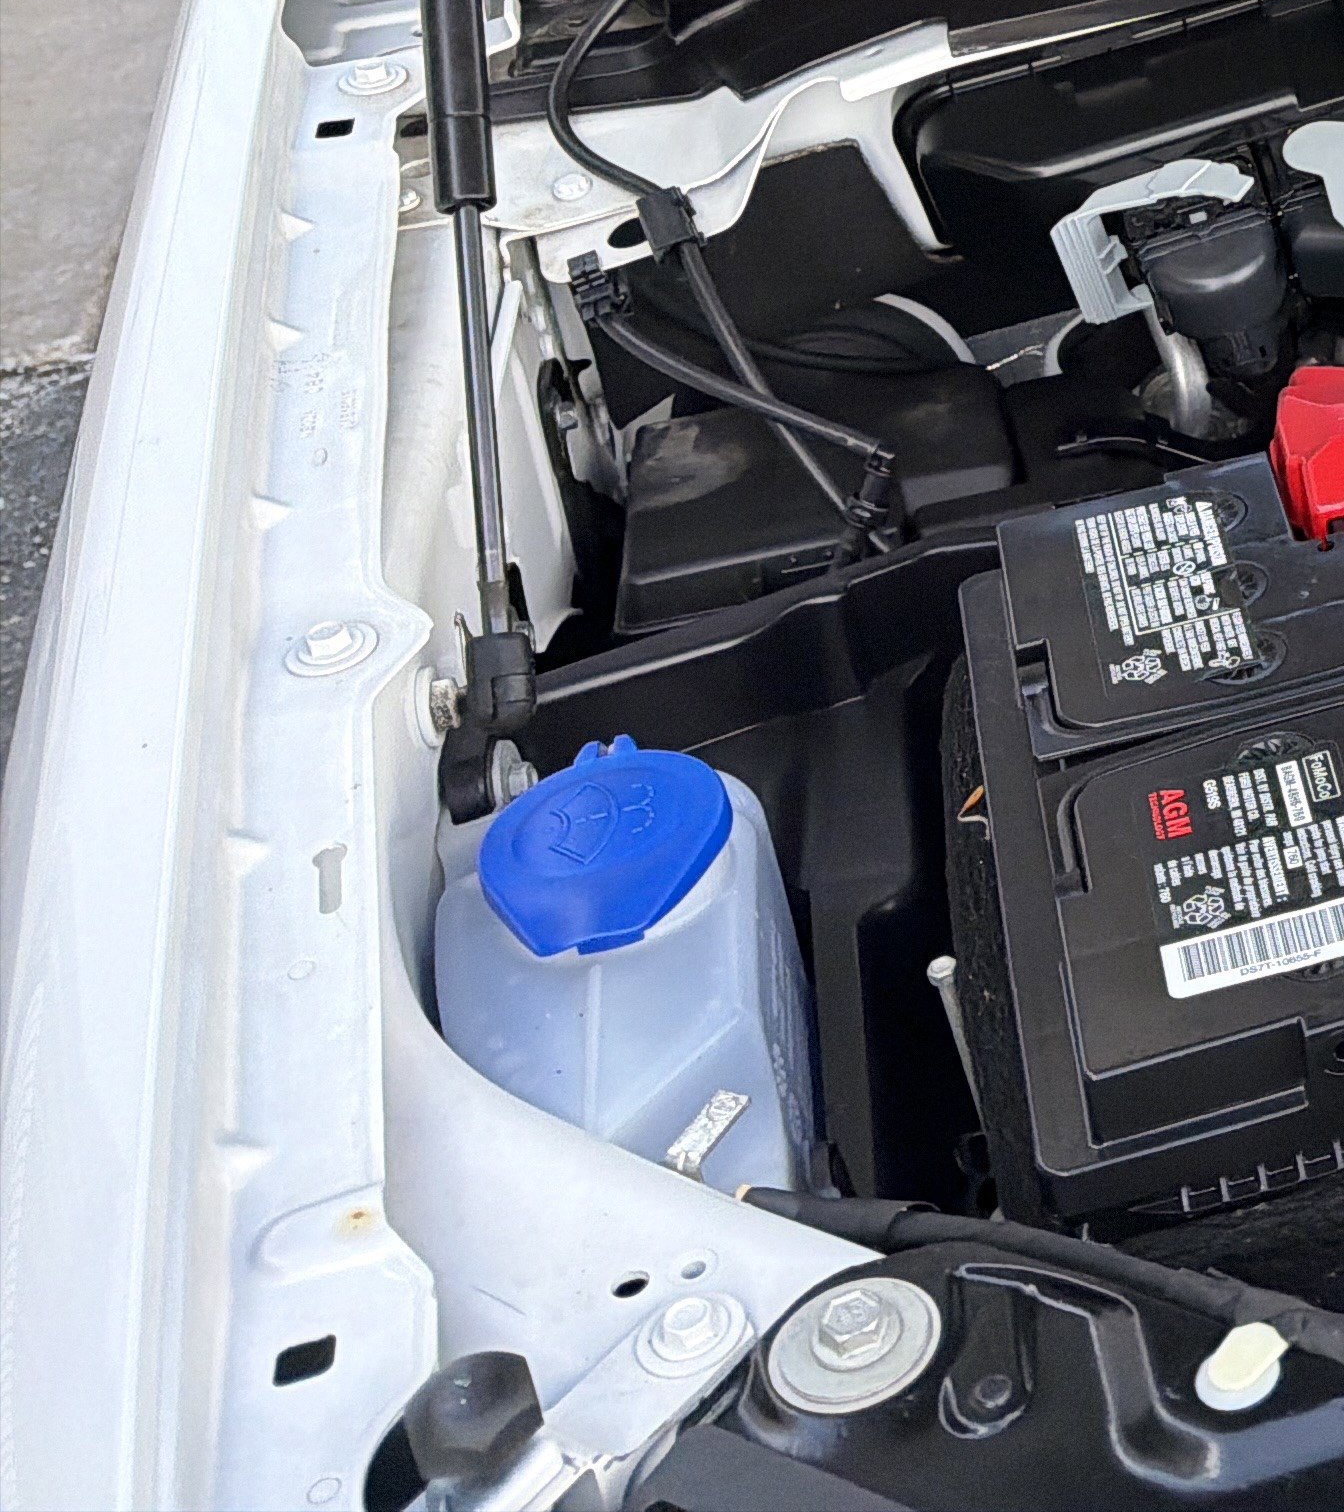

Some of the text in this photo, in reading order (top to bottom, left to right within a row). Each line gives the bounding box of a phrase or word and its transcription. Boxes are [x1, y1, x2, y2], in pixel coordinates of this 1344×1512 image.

[1308, 754, 1332, 800] FoMoCo
[1159, 789, 1192, 837] AGM
[1287, 849, 1300, 866] 760
